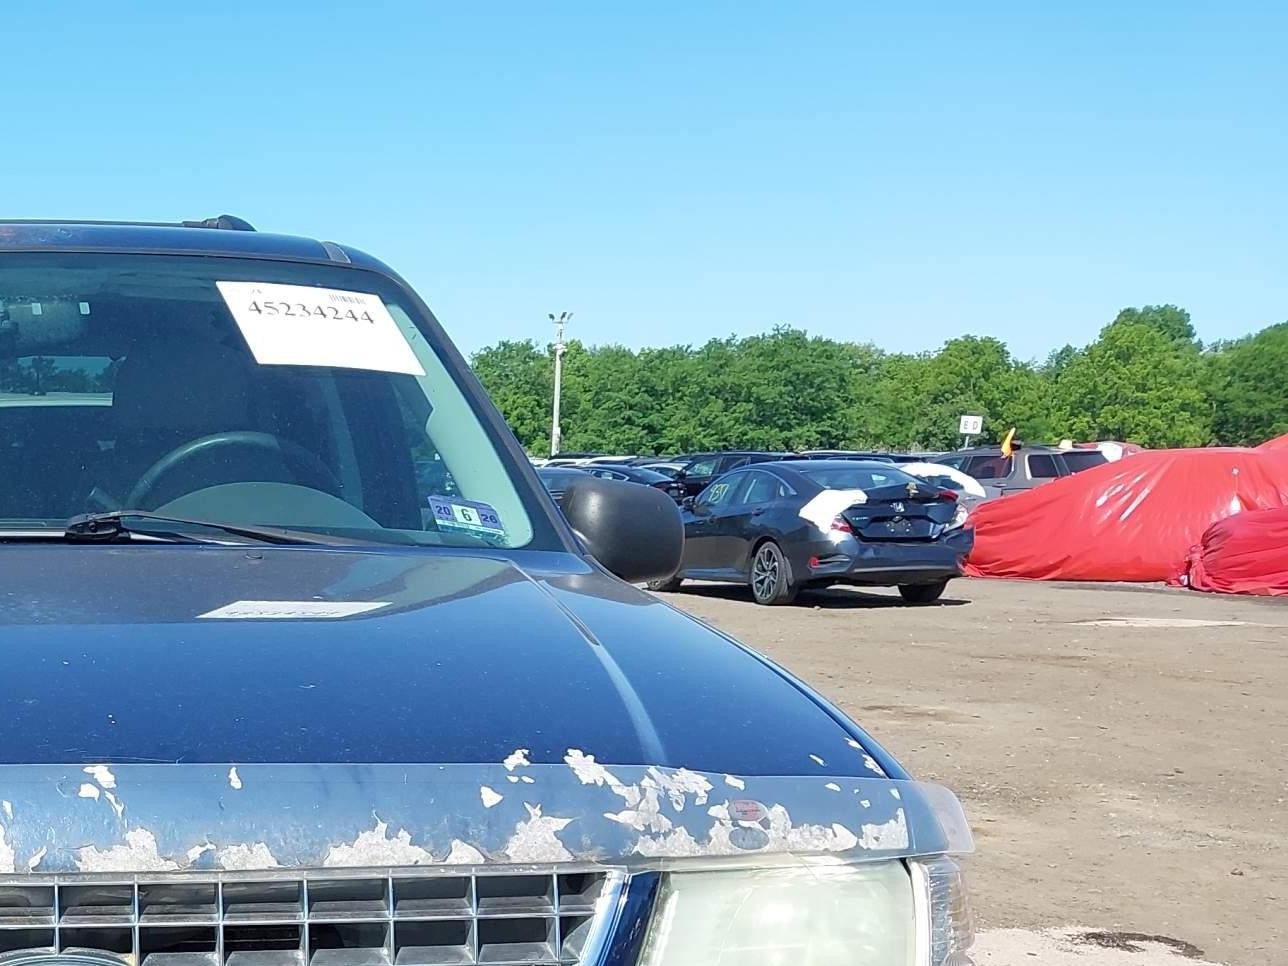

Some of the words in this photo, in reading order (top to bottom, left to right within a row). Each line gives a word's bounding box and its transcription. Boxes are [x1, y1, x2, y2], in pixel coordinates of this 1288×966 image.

[249, 300, 374, 324] 45234244
[435, 505, 451, 516] 20
[461, 508, 472, 522] 6
